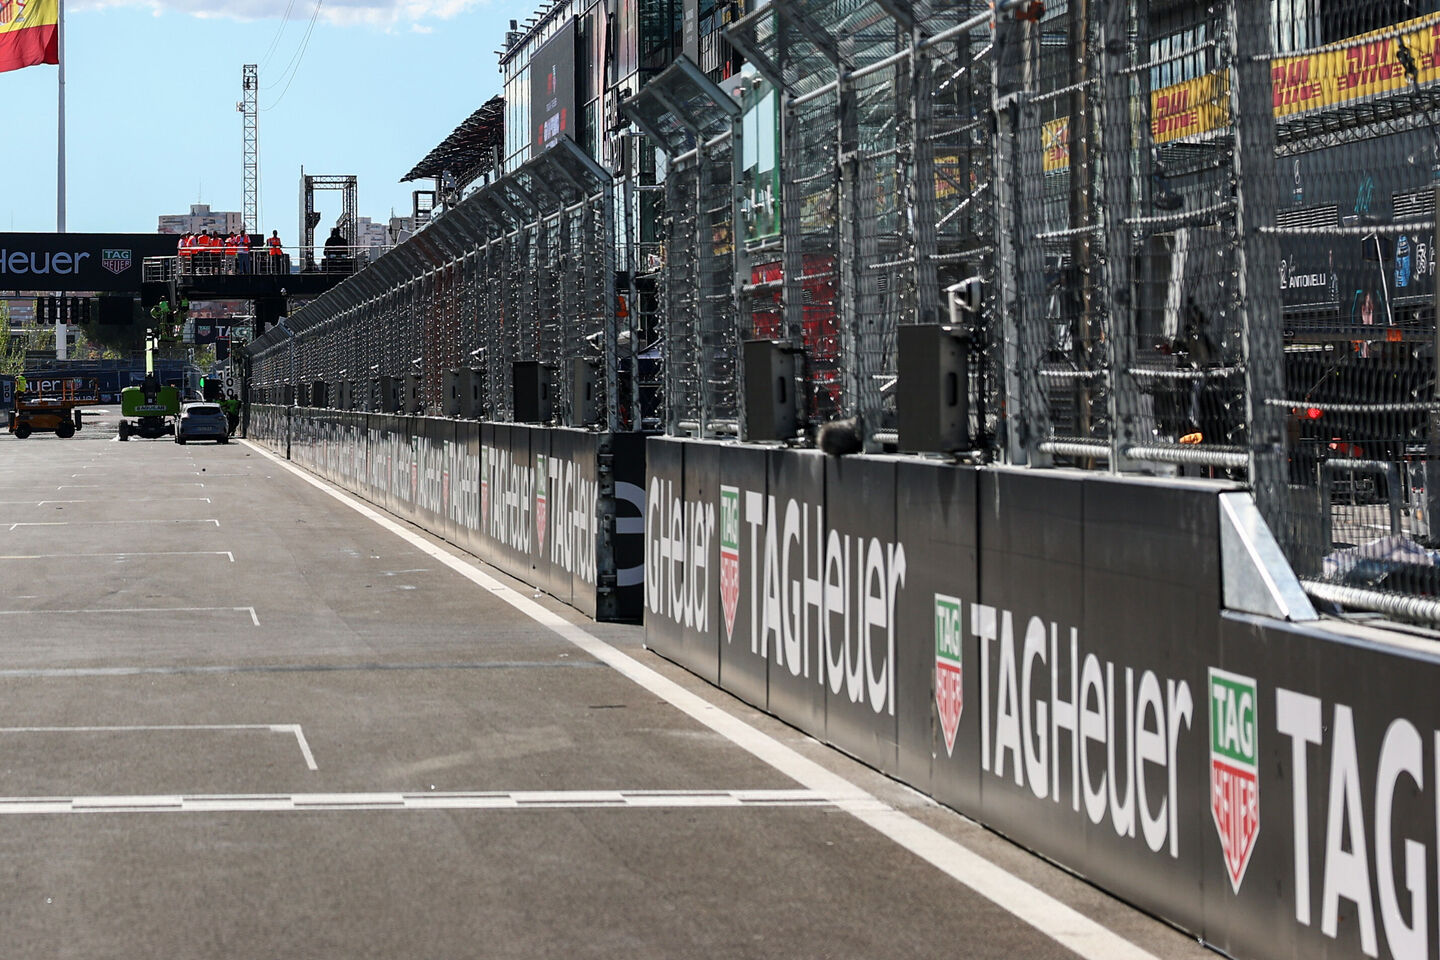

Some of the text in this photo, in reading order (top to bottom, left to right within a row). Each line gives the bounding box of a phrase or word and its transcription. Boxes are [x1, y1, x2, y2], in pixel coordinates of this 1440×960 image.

[104, 261, 130, 271] HEUER
[105, 250, 130, 260] TAG
[721, 496, 738, 544] TAG
[936, 601, 961, 657] TAG
[1212, 682, 1255, 758] TAG
[1212, 767, 1257, 873] HEUER
